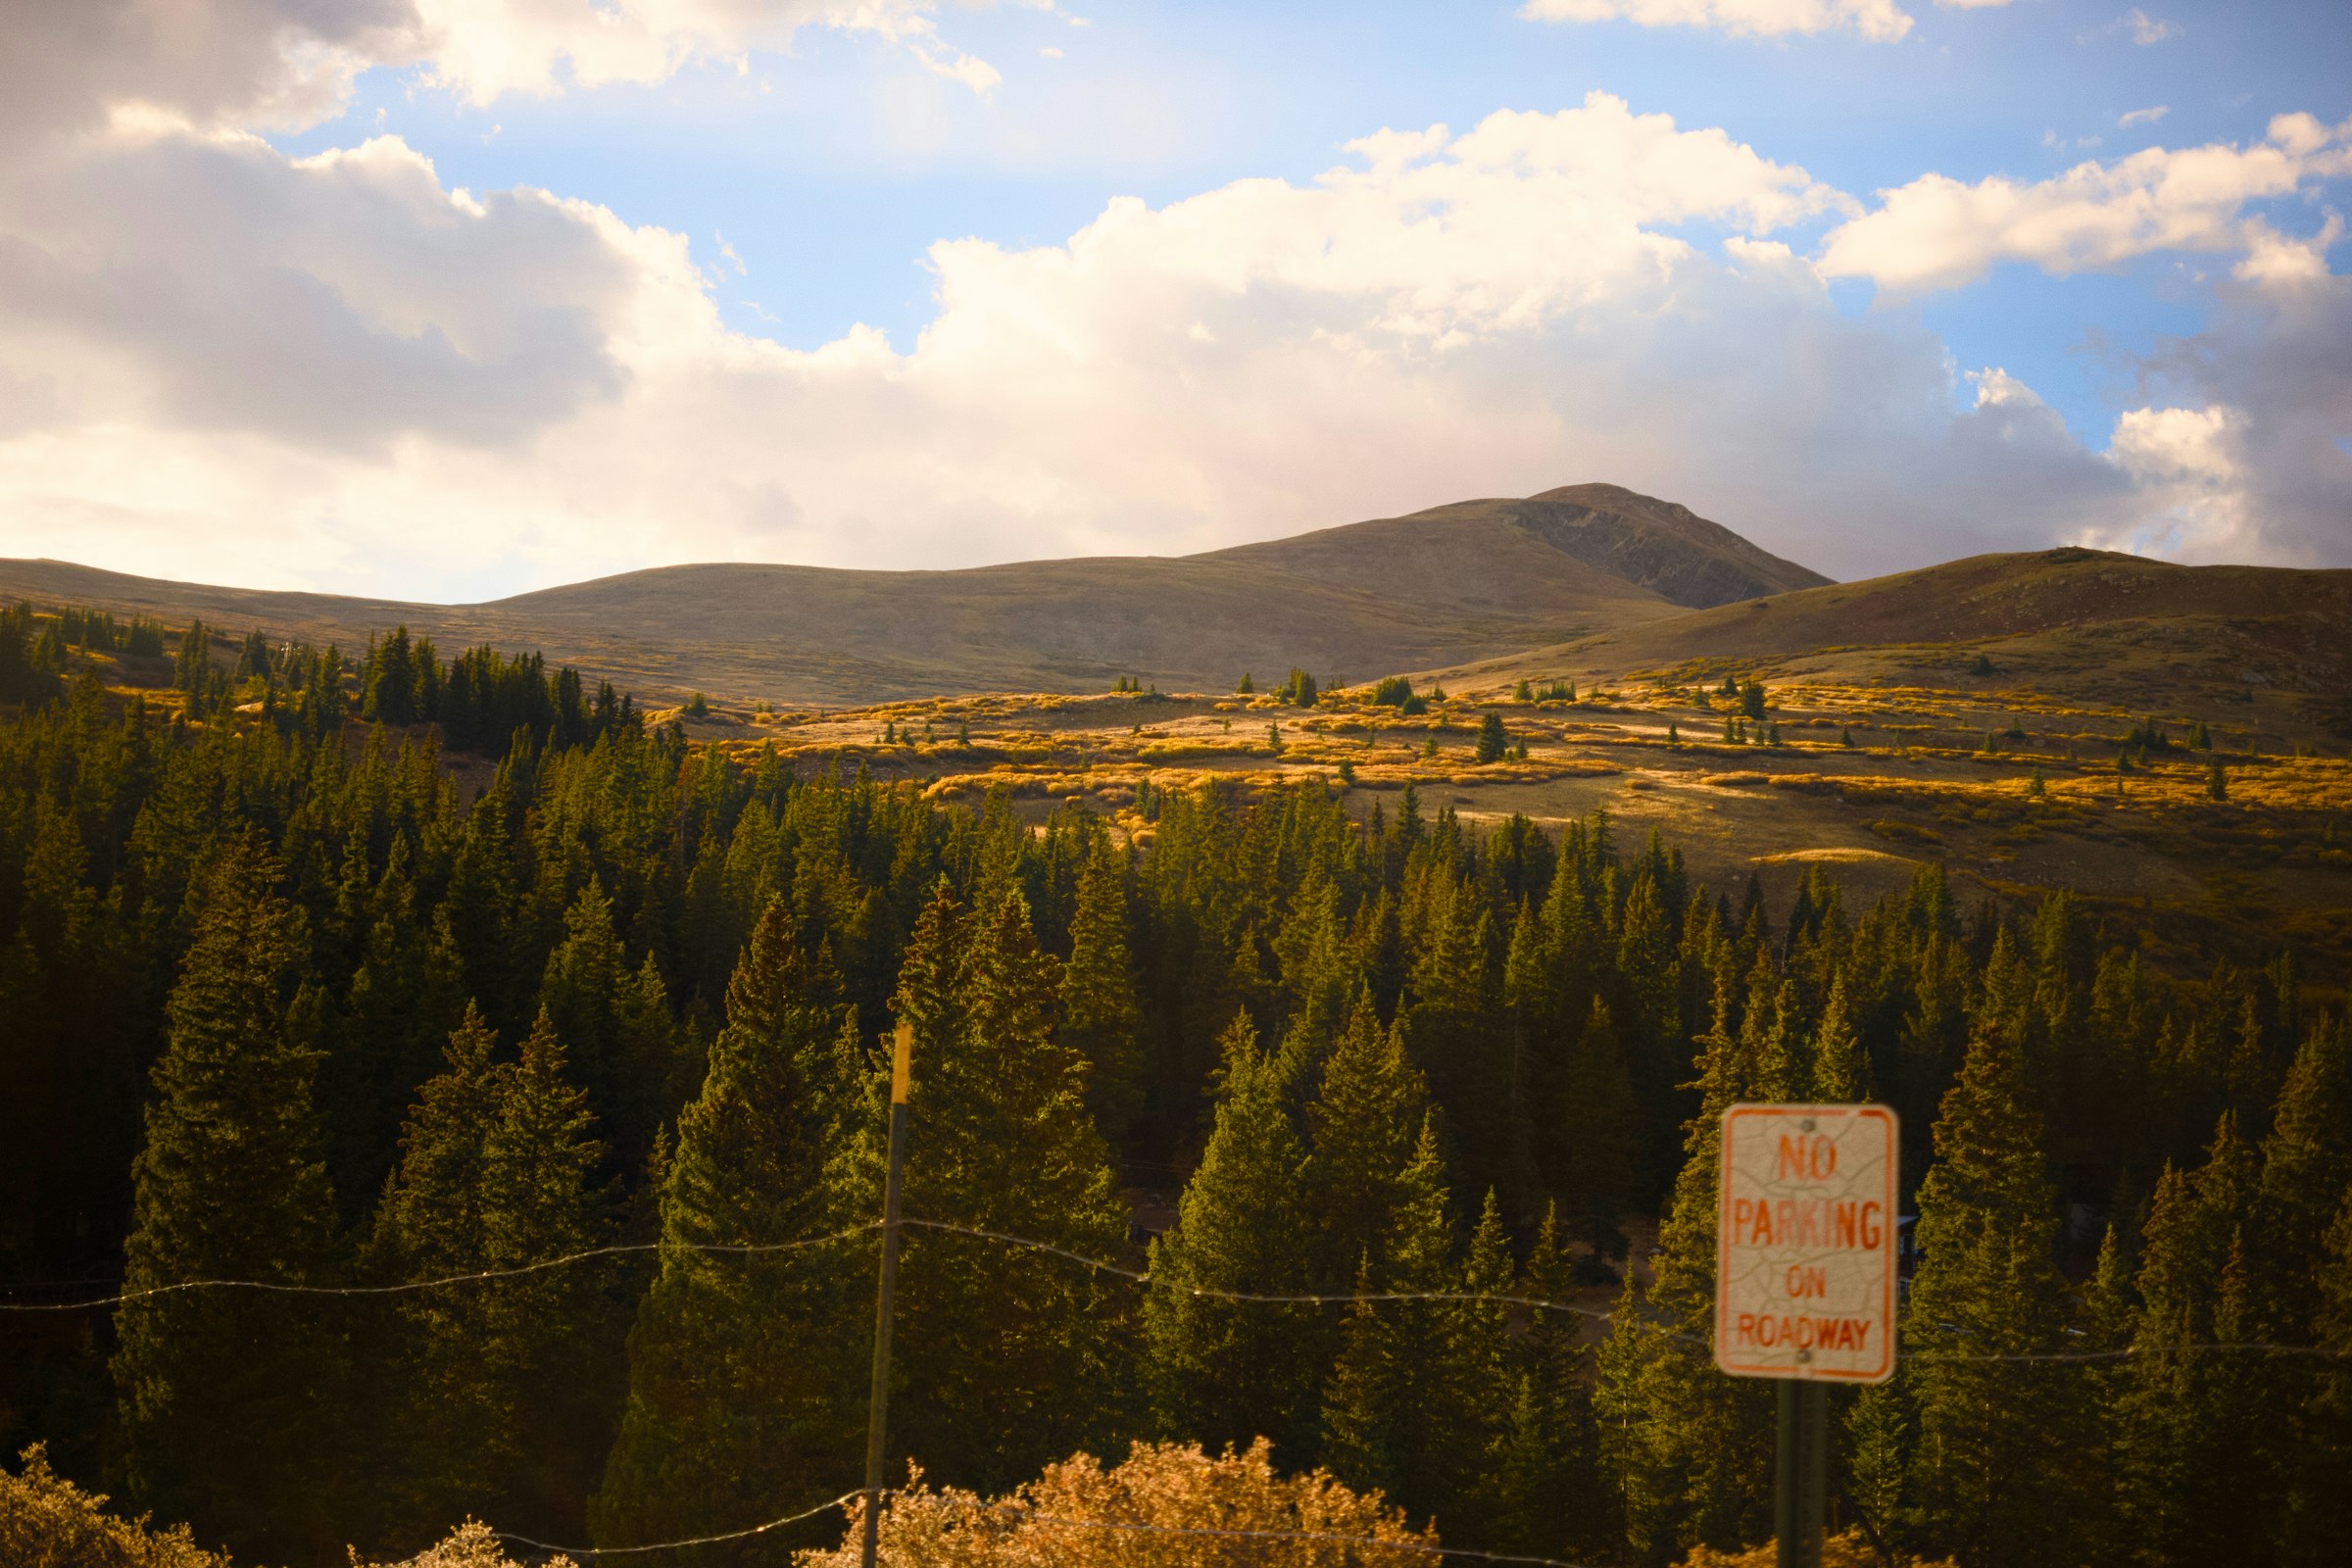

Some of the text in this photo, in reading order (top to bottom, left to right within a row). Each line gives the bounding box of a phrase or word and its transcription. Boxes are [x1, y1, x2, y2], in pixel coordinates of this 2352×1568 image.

[1779, 1134, 1838, 1181] NO
[1733, 1199, 1881, 1250] PARKING
[1786, 1265, 1827, 1298] ON
[1738, 1313, 1872, 1350] ROADWAY
